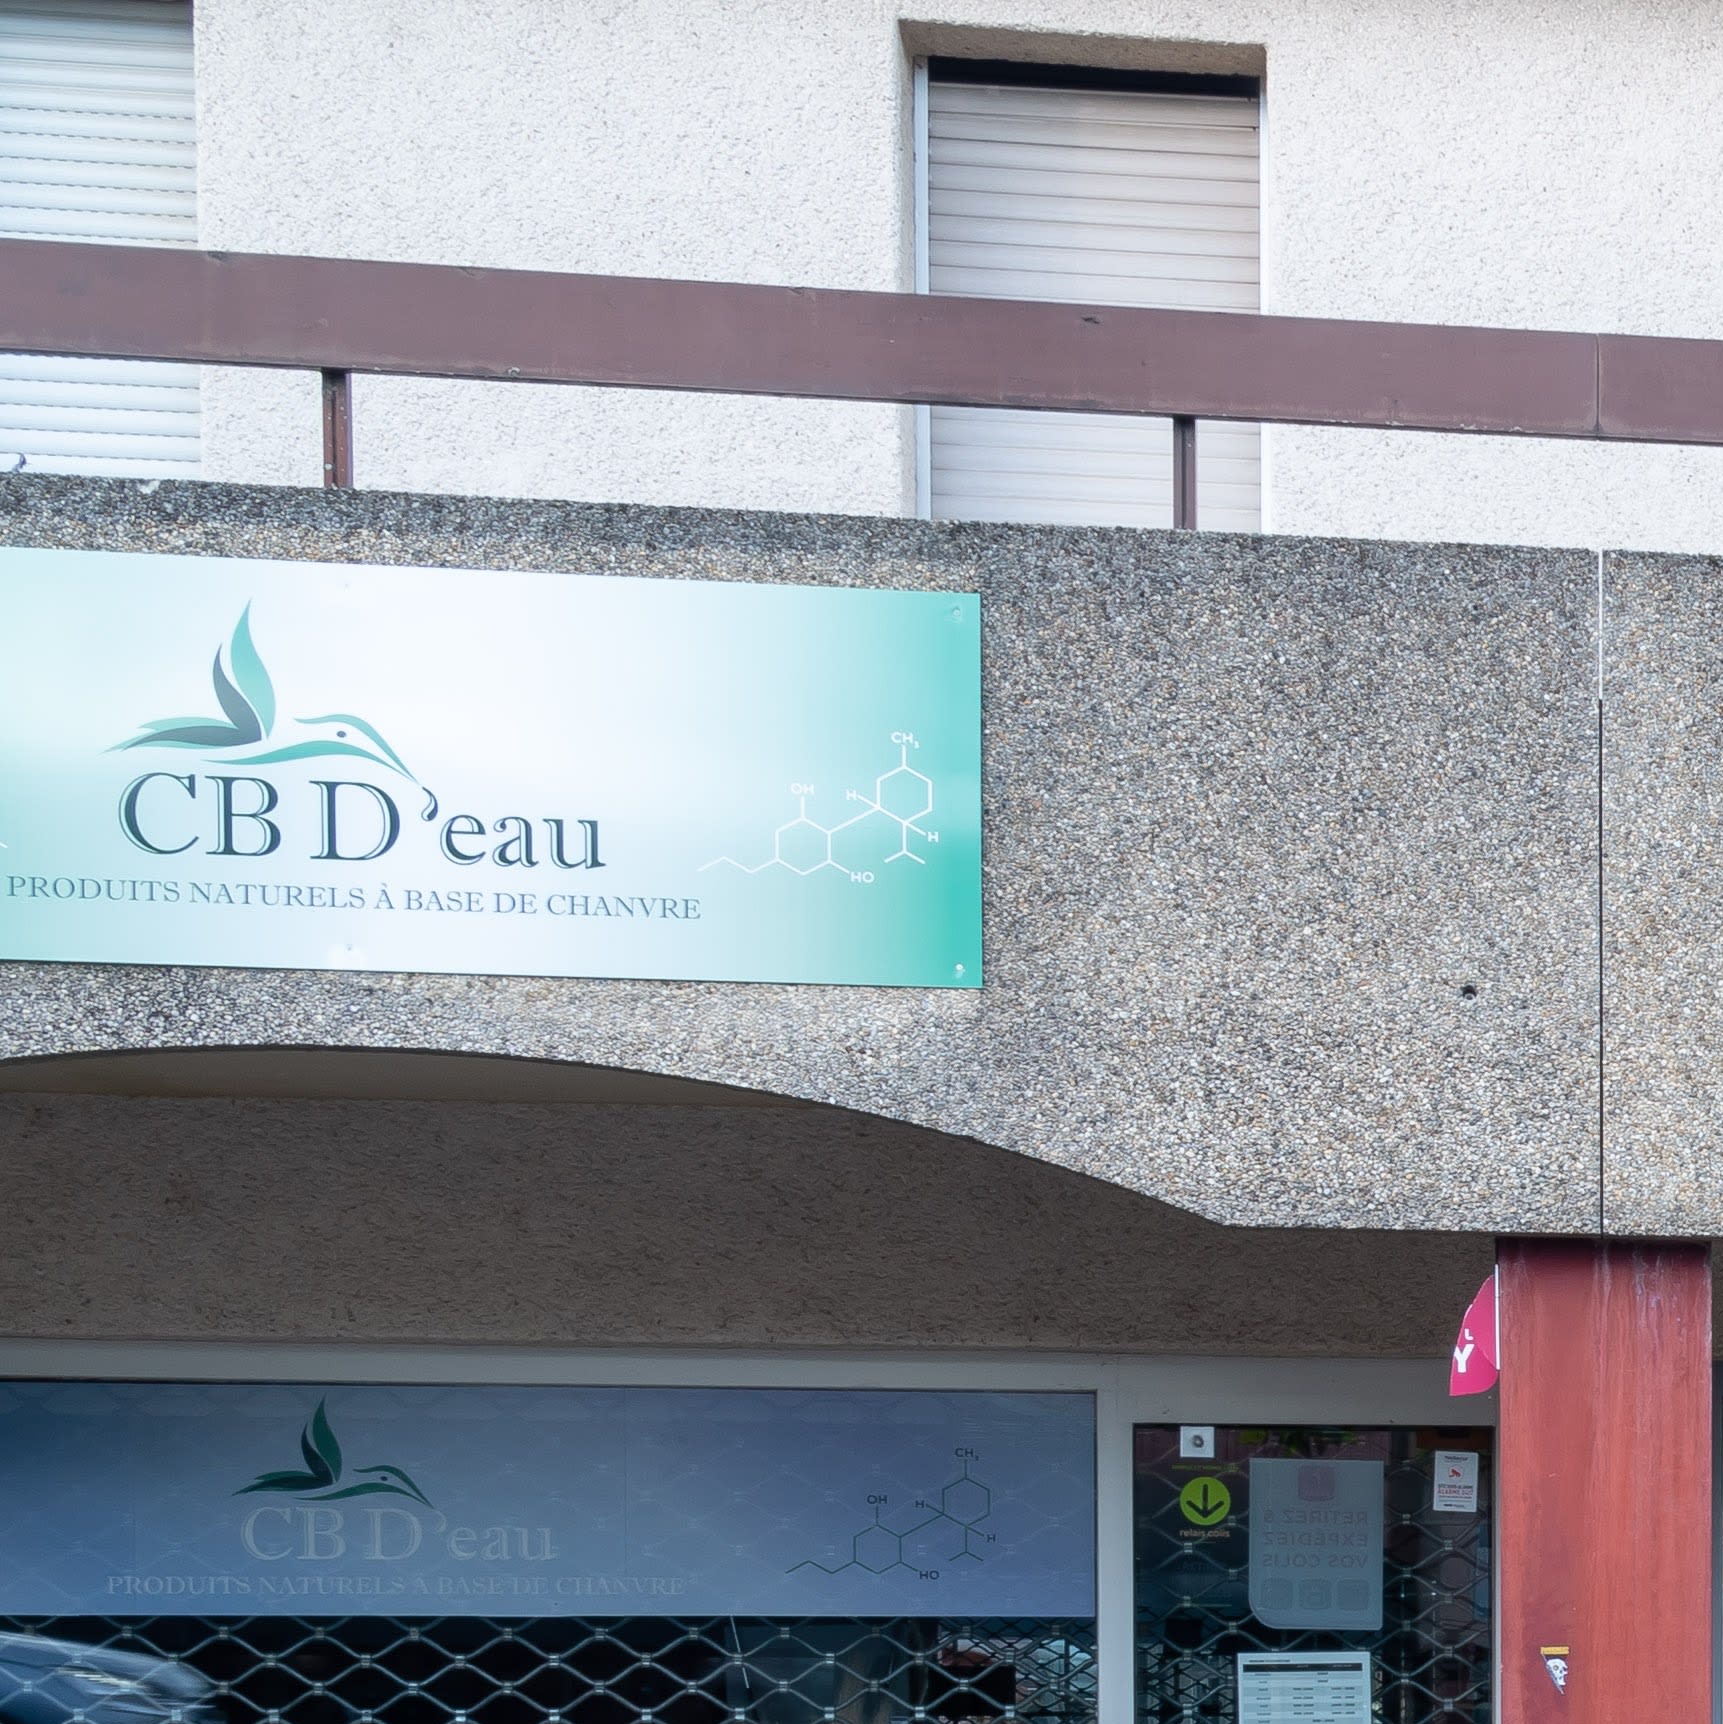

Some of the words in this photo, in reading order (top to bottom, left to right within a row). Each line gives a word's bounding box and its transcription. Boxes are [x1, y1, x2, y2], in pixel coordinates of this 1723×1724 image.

[791, 784, 814, 795] OH
[851, 872, 874, 883] HO
[7, 876, 180, 904] PRODUITS
[188, 883, 366, 910] NATURELS
[373, 884, 395, 910] À
[404, 890, 484, 914] BASE
[493, 892, 538, 916] DE
[547, 895, 700, 920] CHANVRE
